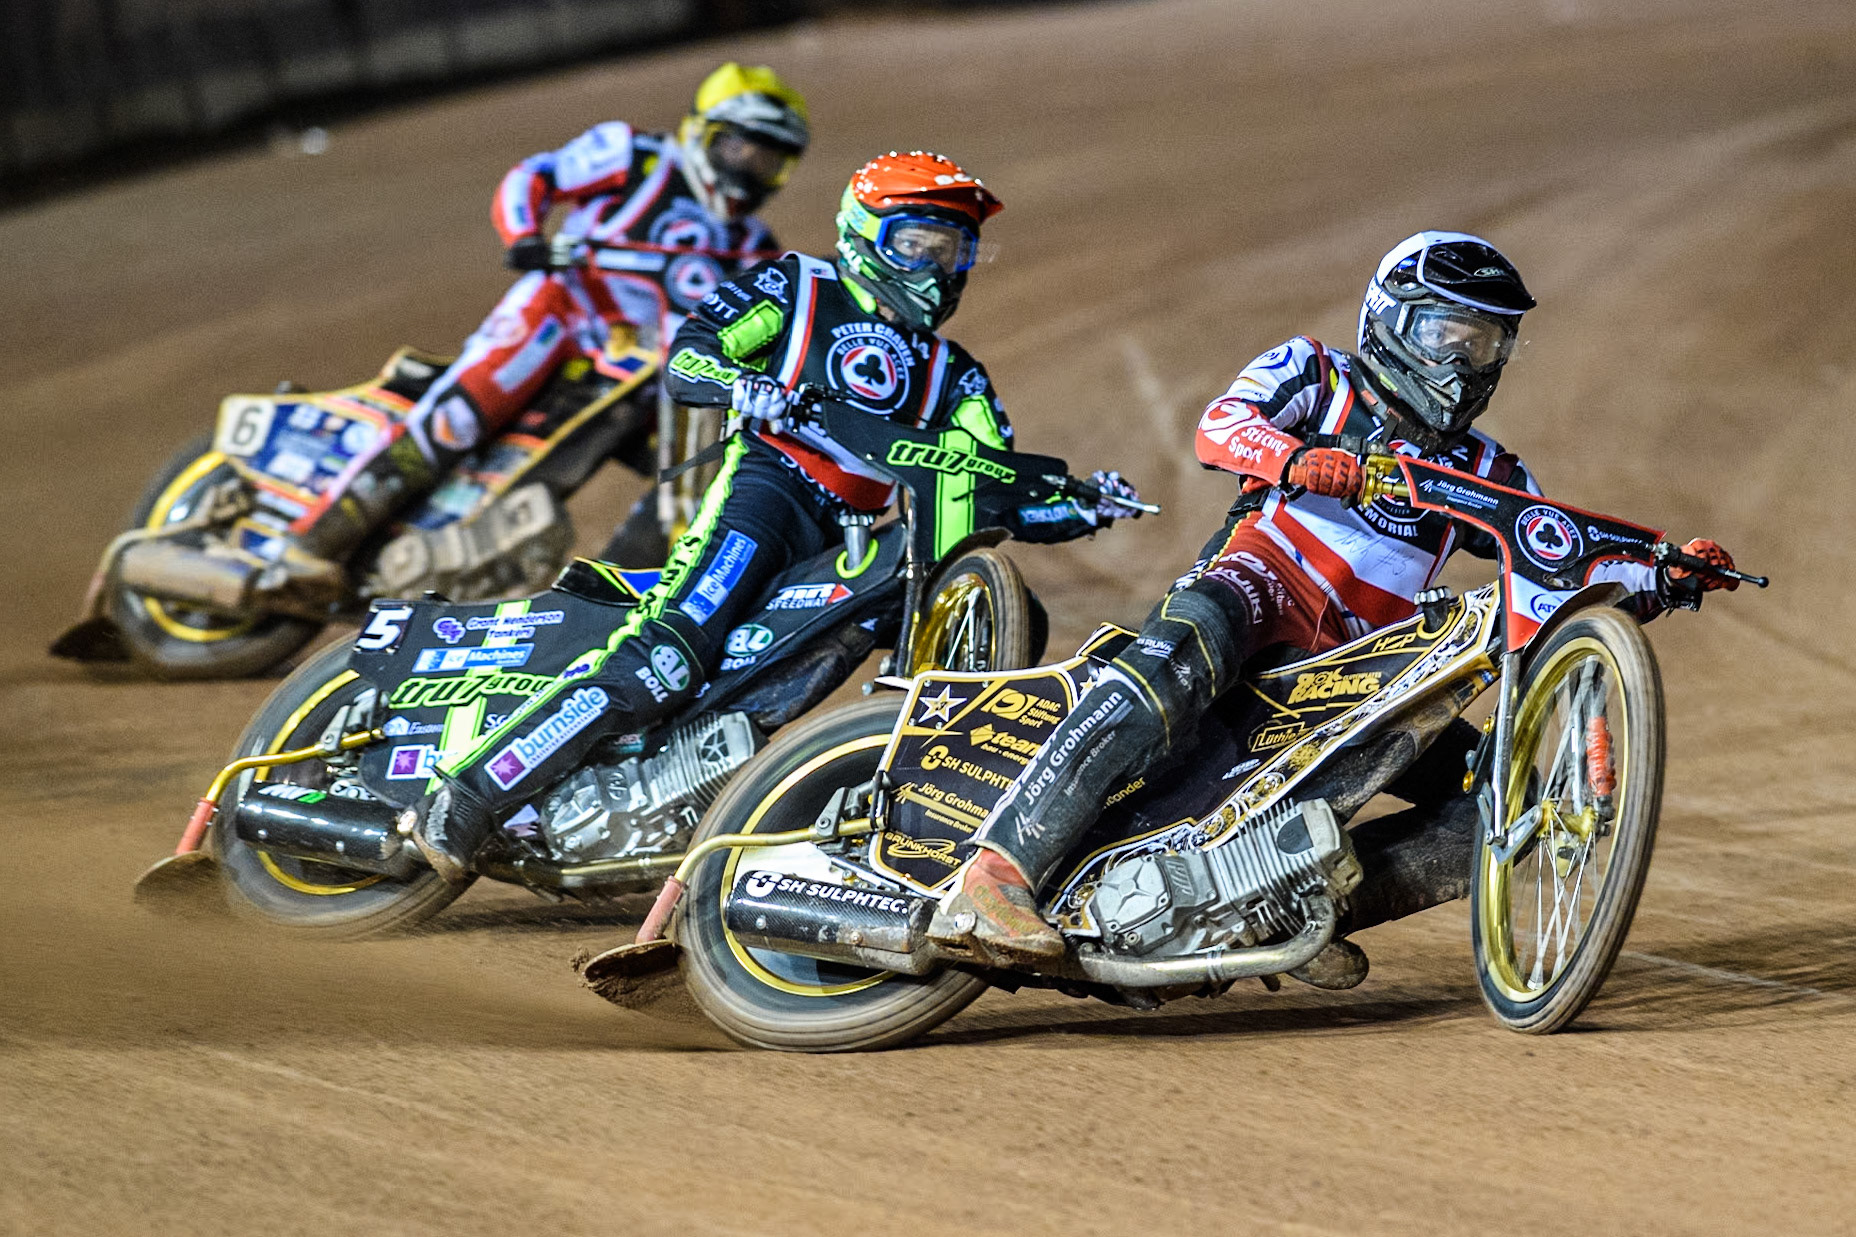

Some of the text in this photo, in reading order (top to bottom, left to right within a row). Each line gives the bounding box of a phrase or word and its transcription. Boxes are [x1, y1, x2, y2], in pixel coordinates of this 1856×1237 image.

[831, 322, 916, 367] PETER CRAVEN
[836, 338, 865, 355] BELLE
[868, 338, 890, 351] VUE
[233, 406, 261, 447] 6
[1228, 436, 1263, 464] Sport
[1437, 480, 1499, 505] Jörg Grohmann
[1521, 508, 1578, 540] BELLE VUE ACES
[702, 581, 720, 599] Ice
[714, 538, 747, 583] Machines
[362, 608, 414, 650] 5
[389, 674, 553, 708] tru7grou
[635, 665, 669, 703] BOLL
[1287, 678, 1380, 704] RACING
[1019, 714, 1043, 729] Sport
[1027, 707, 1061, 725] Stiftung
[1036, 698, 1061, 712] ADAC
[516, 689, 604, 759] burnside
[1024, 691, 1122, 806] Jörg Grohmann
[1063, 730, 1117, 797] Insurance Broker
[941, 756, 1015, 791] SH SULPHTE
[918, 782, 990, 818] Jörg Grohma
[925, 809, 975, 834] Insurance Broker
[885, 832, 962, 866] BRUNKHORST
[777, 878, 804, 893] SH
